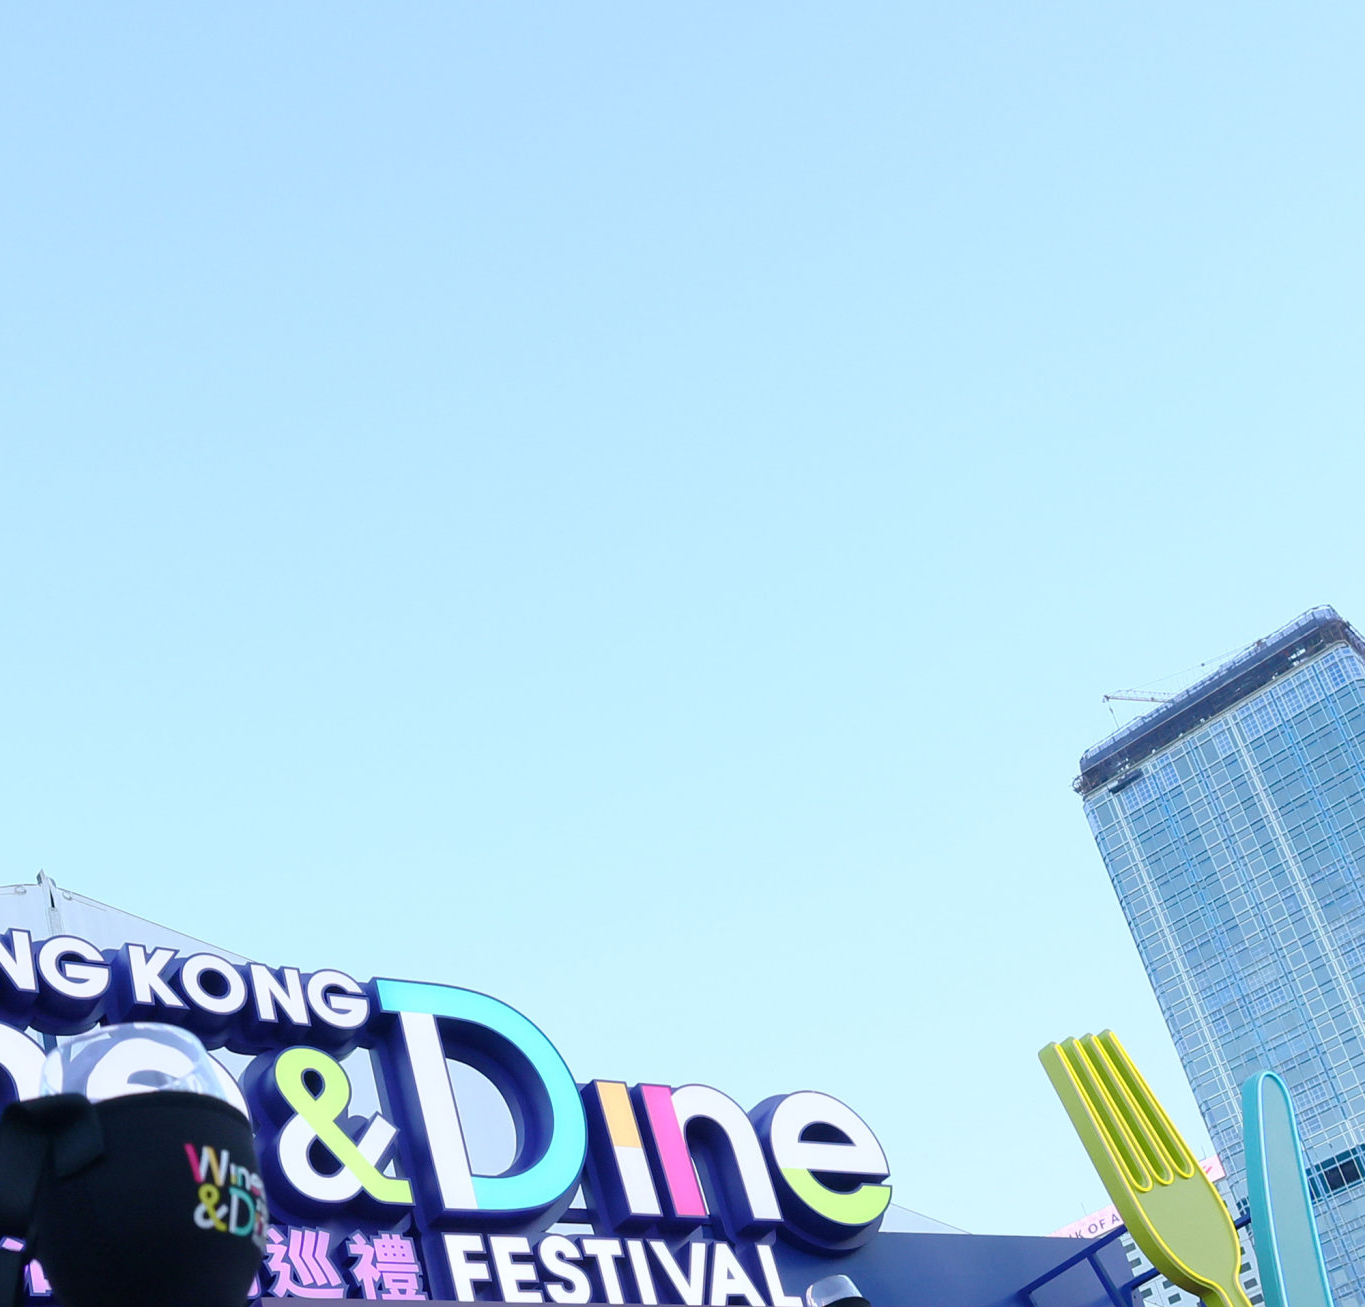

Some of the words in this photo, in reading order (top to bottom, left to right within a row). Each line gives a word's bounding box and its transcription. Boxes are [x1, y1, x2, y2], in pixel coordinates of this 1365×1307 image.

[127, 943, 370, 1029] KONG
[275, 1045, 414, 1206] &
[376, 977, 893, 1226] Dine
[193, 1183, 229, 1232] &
[443, 1233, 803, 1307] FESTIVAL
